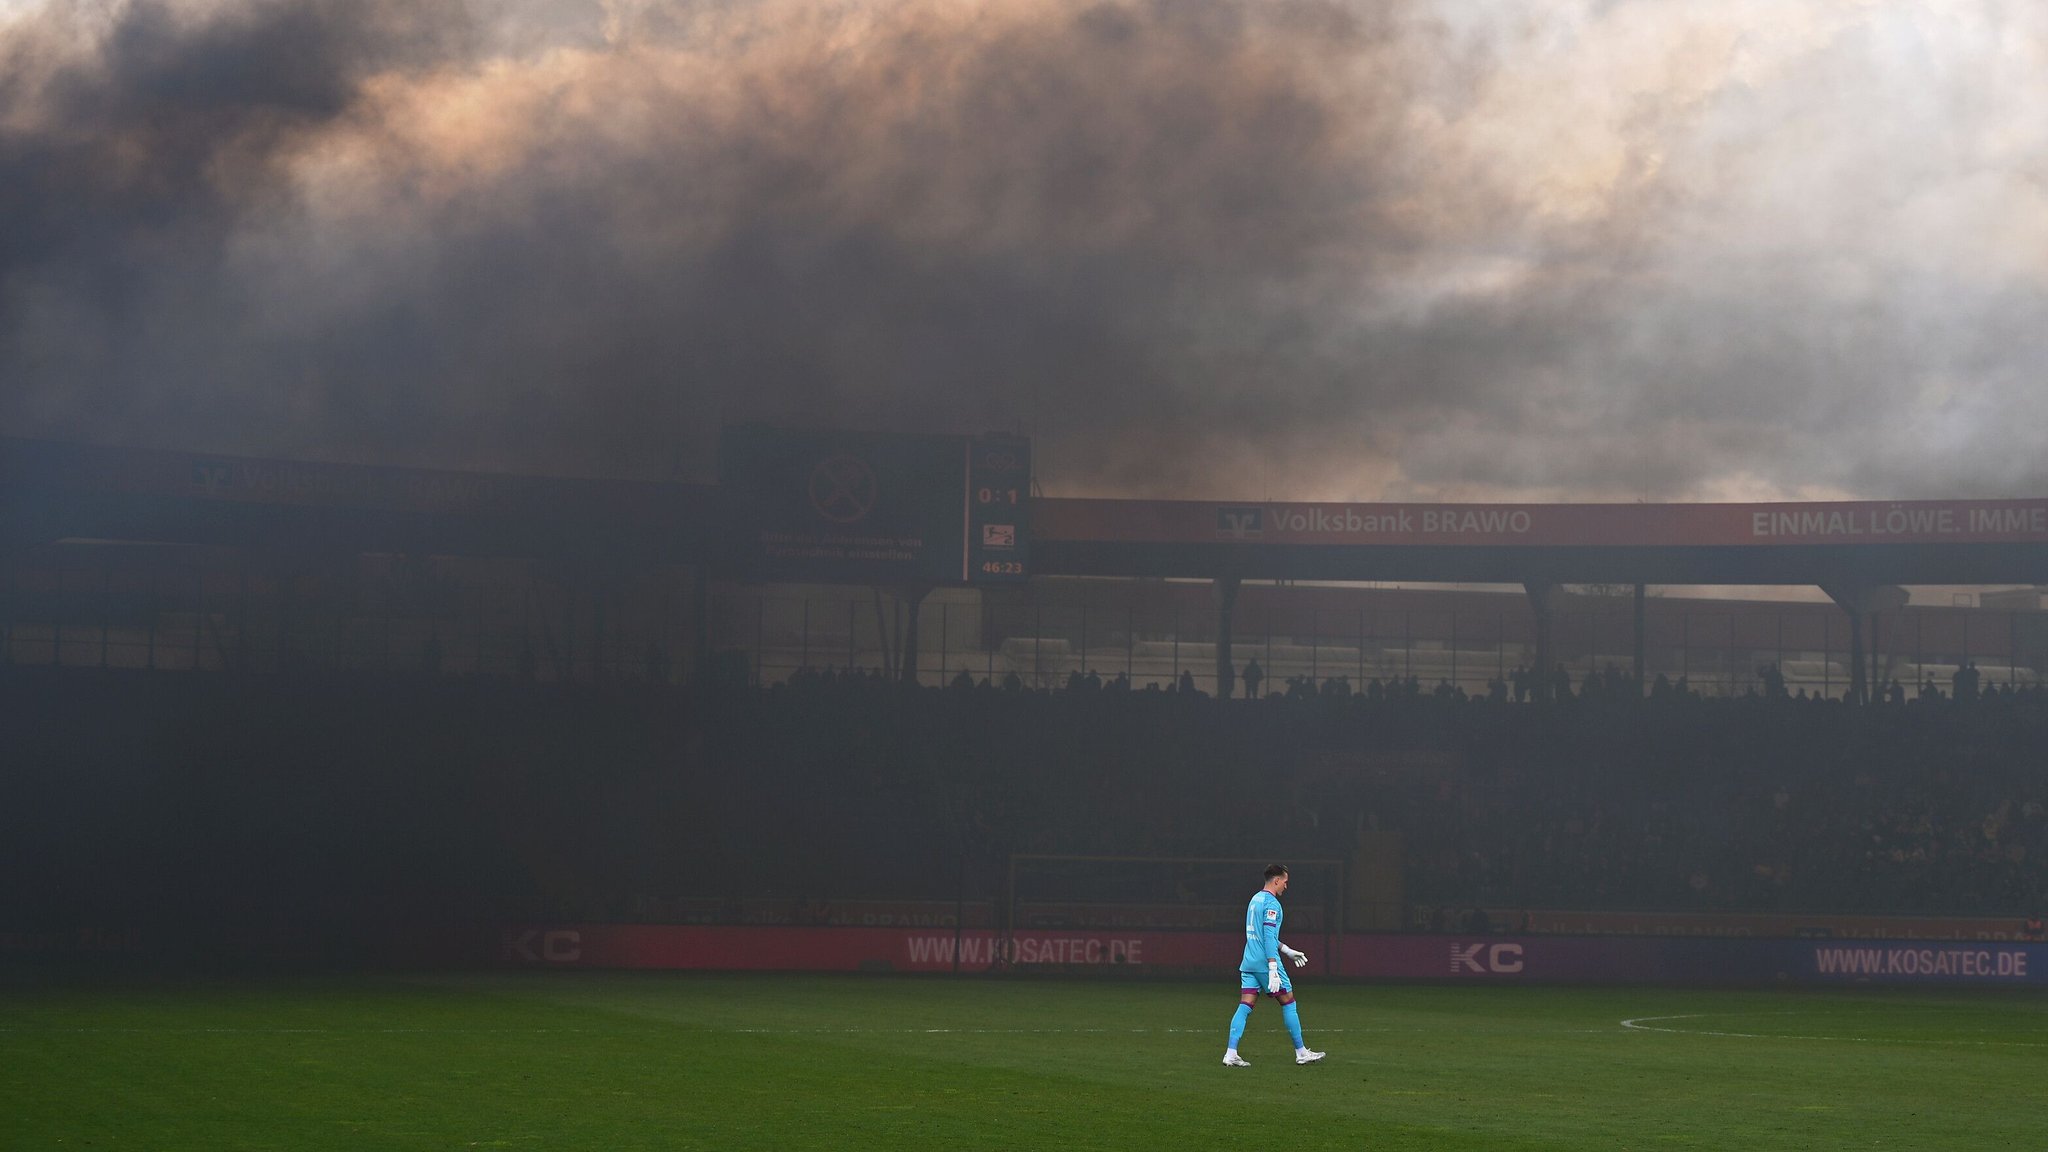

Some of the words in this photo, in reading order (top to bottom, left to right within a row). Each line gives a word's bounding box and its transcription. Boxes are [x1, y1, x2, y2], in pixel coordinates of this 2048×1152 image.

[1271, 508, 1413, 532] Volksbank
[1422, 510, 1532, 533] BRAWO
[1752, 511, 1864, 536] EINMAL
[1870, 504, 1961, 534] LÖWE.
[1968, 507, 2048, 533] IMME
[982, 561, 1022, 574] 46:23
[502, 928, 582, 963] KC
[1450, 943, 1525, 974] KC
[1815, 948, 2028, 976] WWW.KOSATEC.DE
